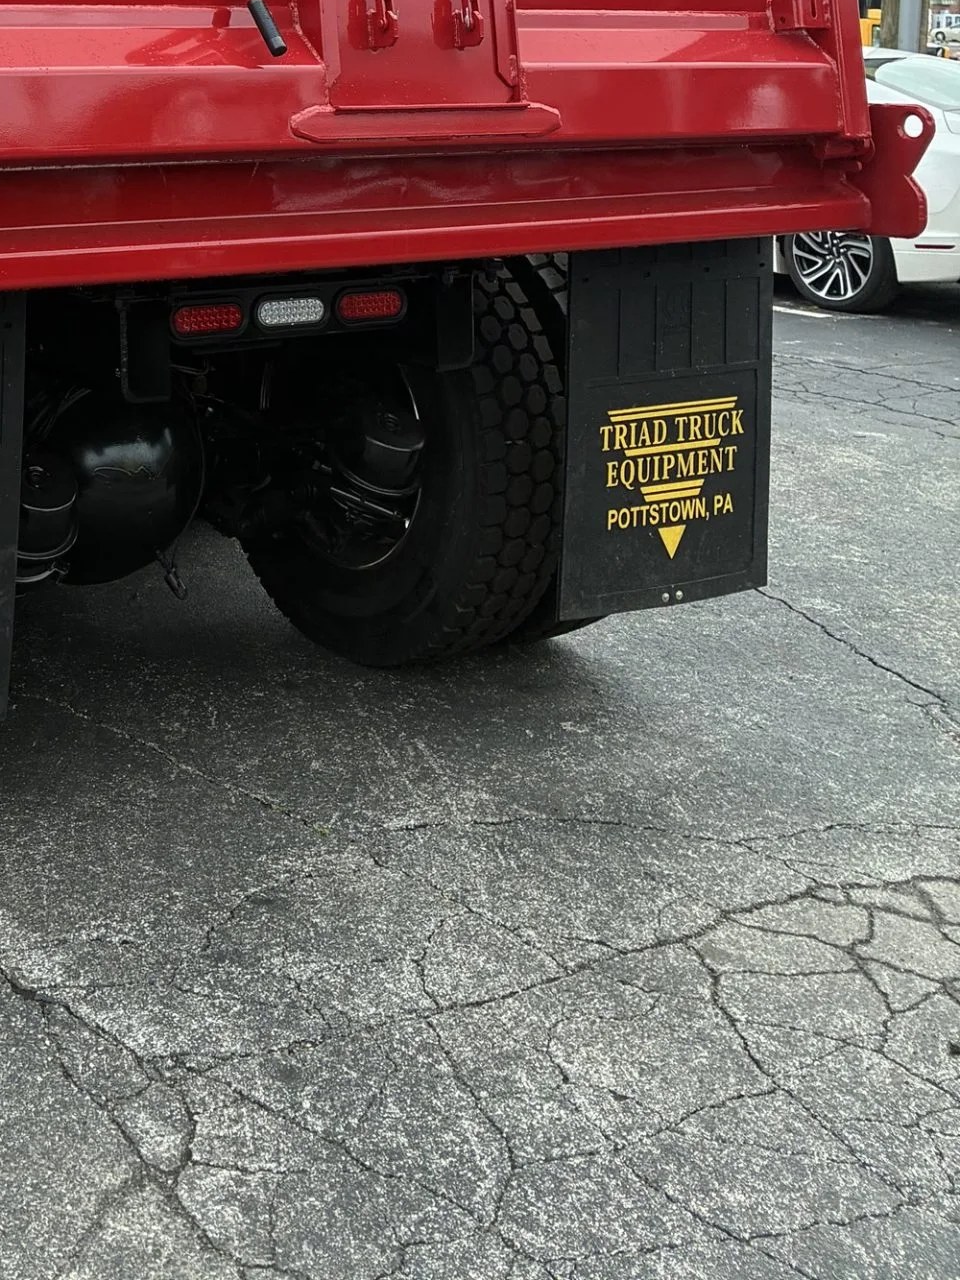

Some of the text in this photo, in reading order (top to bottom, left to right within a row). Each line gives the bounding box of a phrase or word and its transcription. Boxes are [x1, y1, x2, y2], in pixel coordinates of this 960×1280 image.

[599, 409, 744, 452] TRIAD TRUCK
[606, 446, 737, 490] EQUIPMENT
[607, 493, 734, 530] POTTSTOWN, PA
